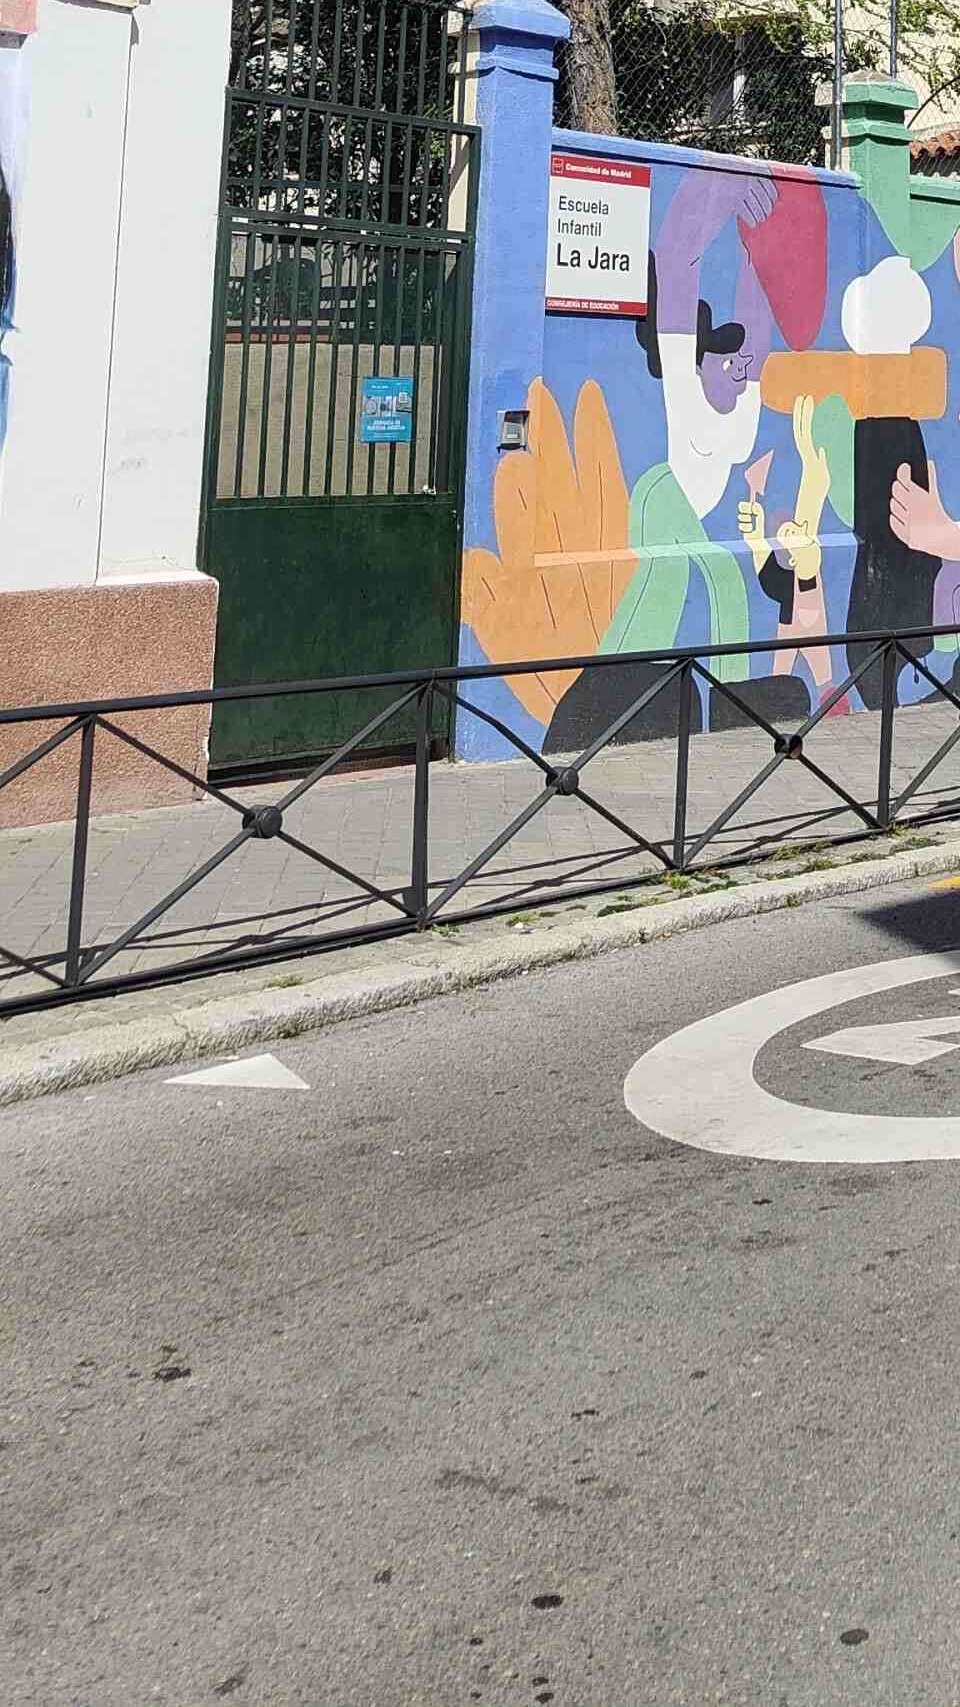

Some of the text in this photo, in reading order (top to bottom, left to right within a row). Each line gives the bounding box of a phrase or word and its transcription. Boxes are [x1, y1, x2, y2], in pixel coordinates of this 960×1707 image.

[565, 163, 632, 179] Comunidad de Madrid
[559, 196, 609, 215] Escuela
[557, 219, 602, 237] Infantil
[557, 243, 630, 271] La Jara
[582, 301, 590, 309] DE
